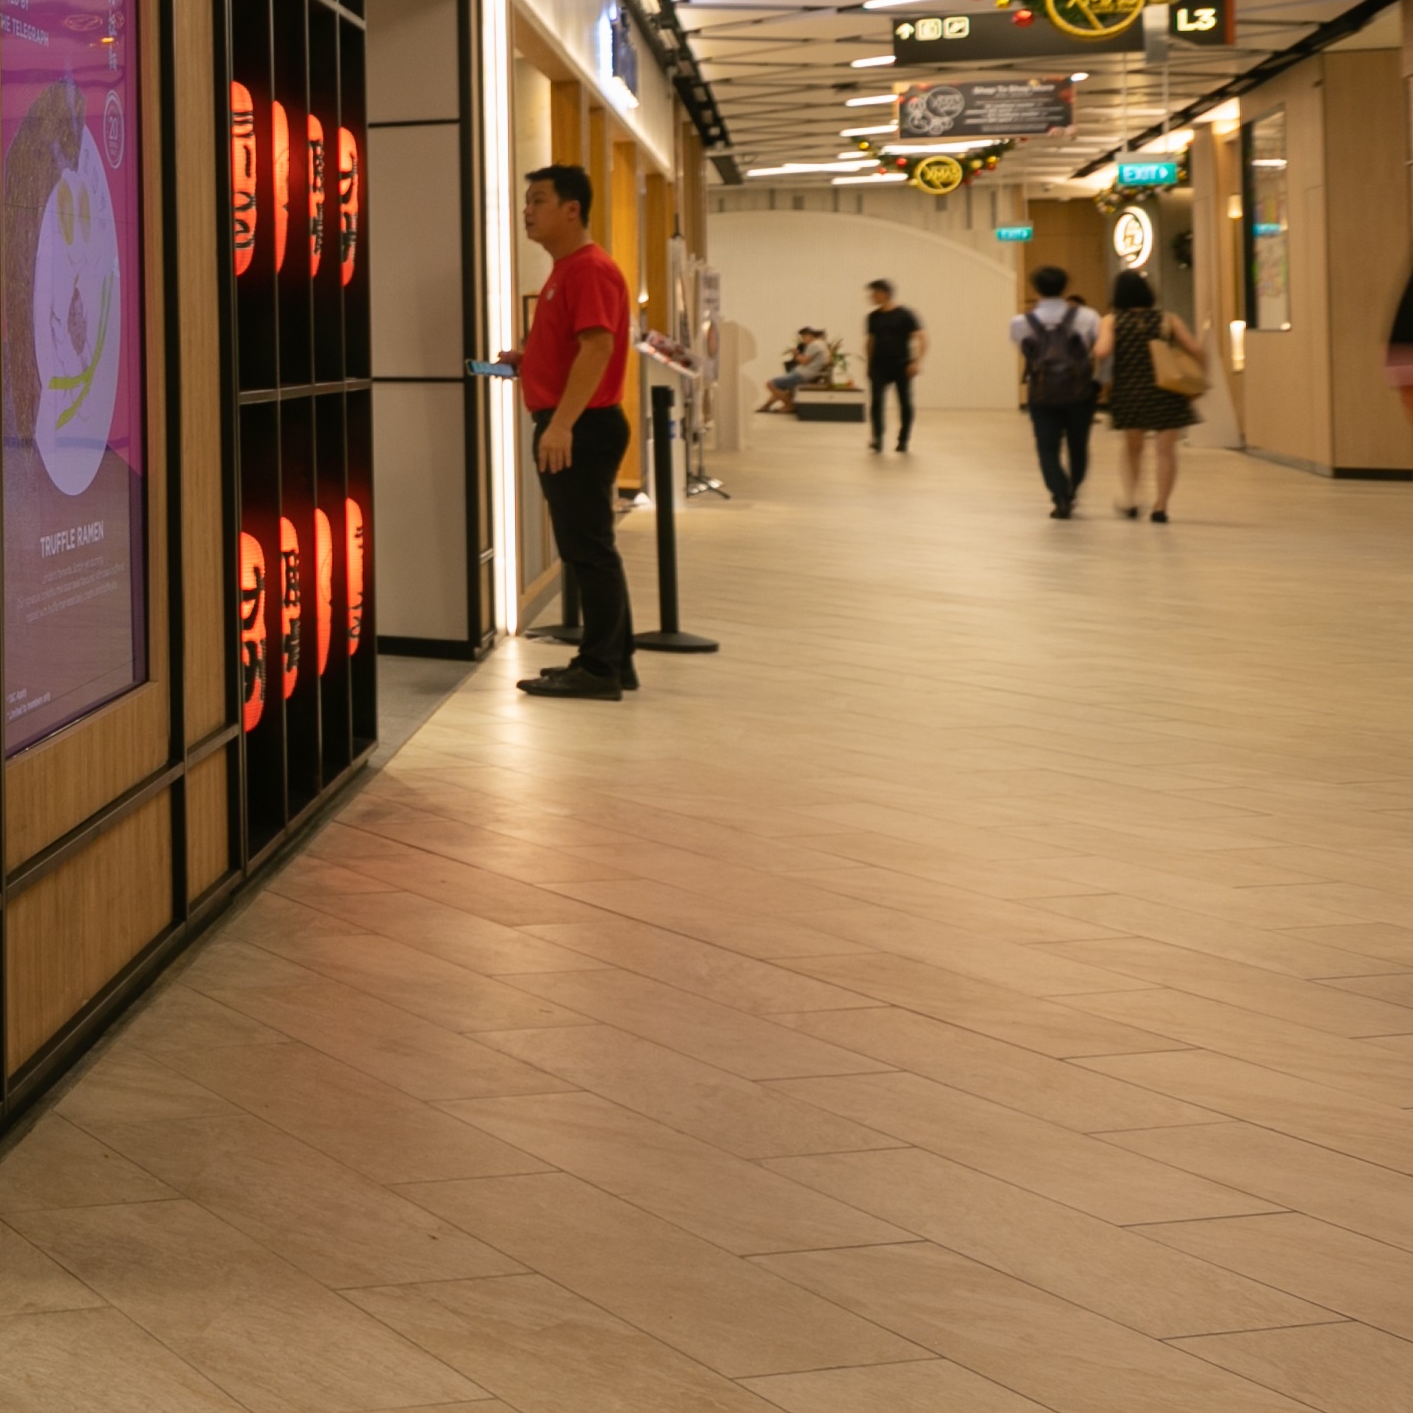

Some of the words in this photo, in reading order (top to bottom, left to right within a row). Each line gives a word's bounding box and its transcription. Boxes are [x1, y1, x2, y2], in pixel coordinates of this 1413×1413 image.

[11, 17, 50, 48] TELEGRAPH
[1176, 7, 1217, 32] L3
[1123, 165, 1158, 183] EXIT
[40, 527, 76, 559] TRUFFLE
[76, 520, 104, 547] RAMEN
